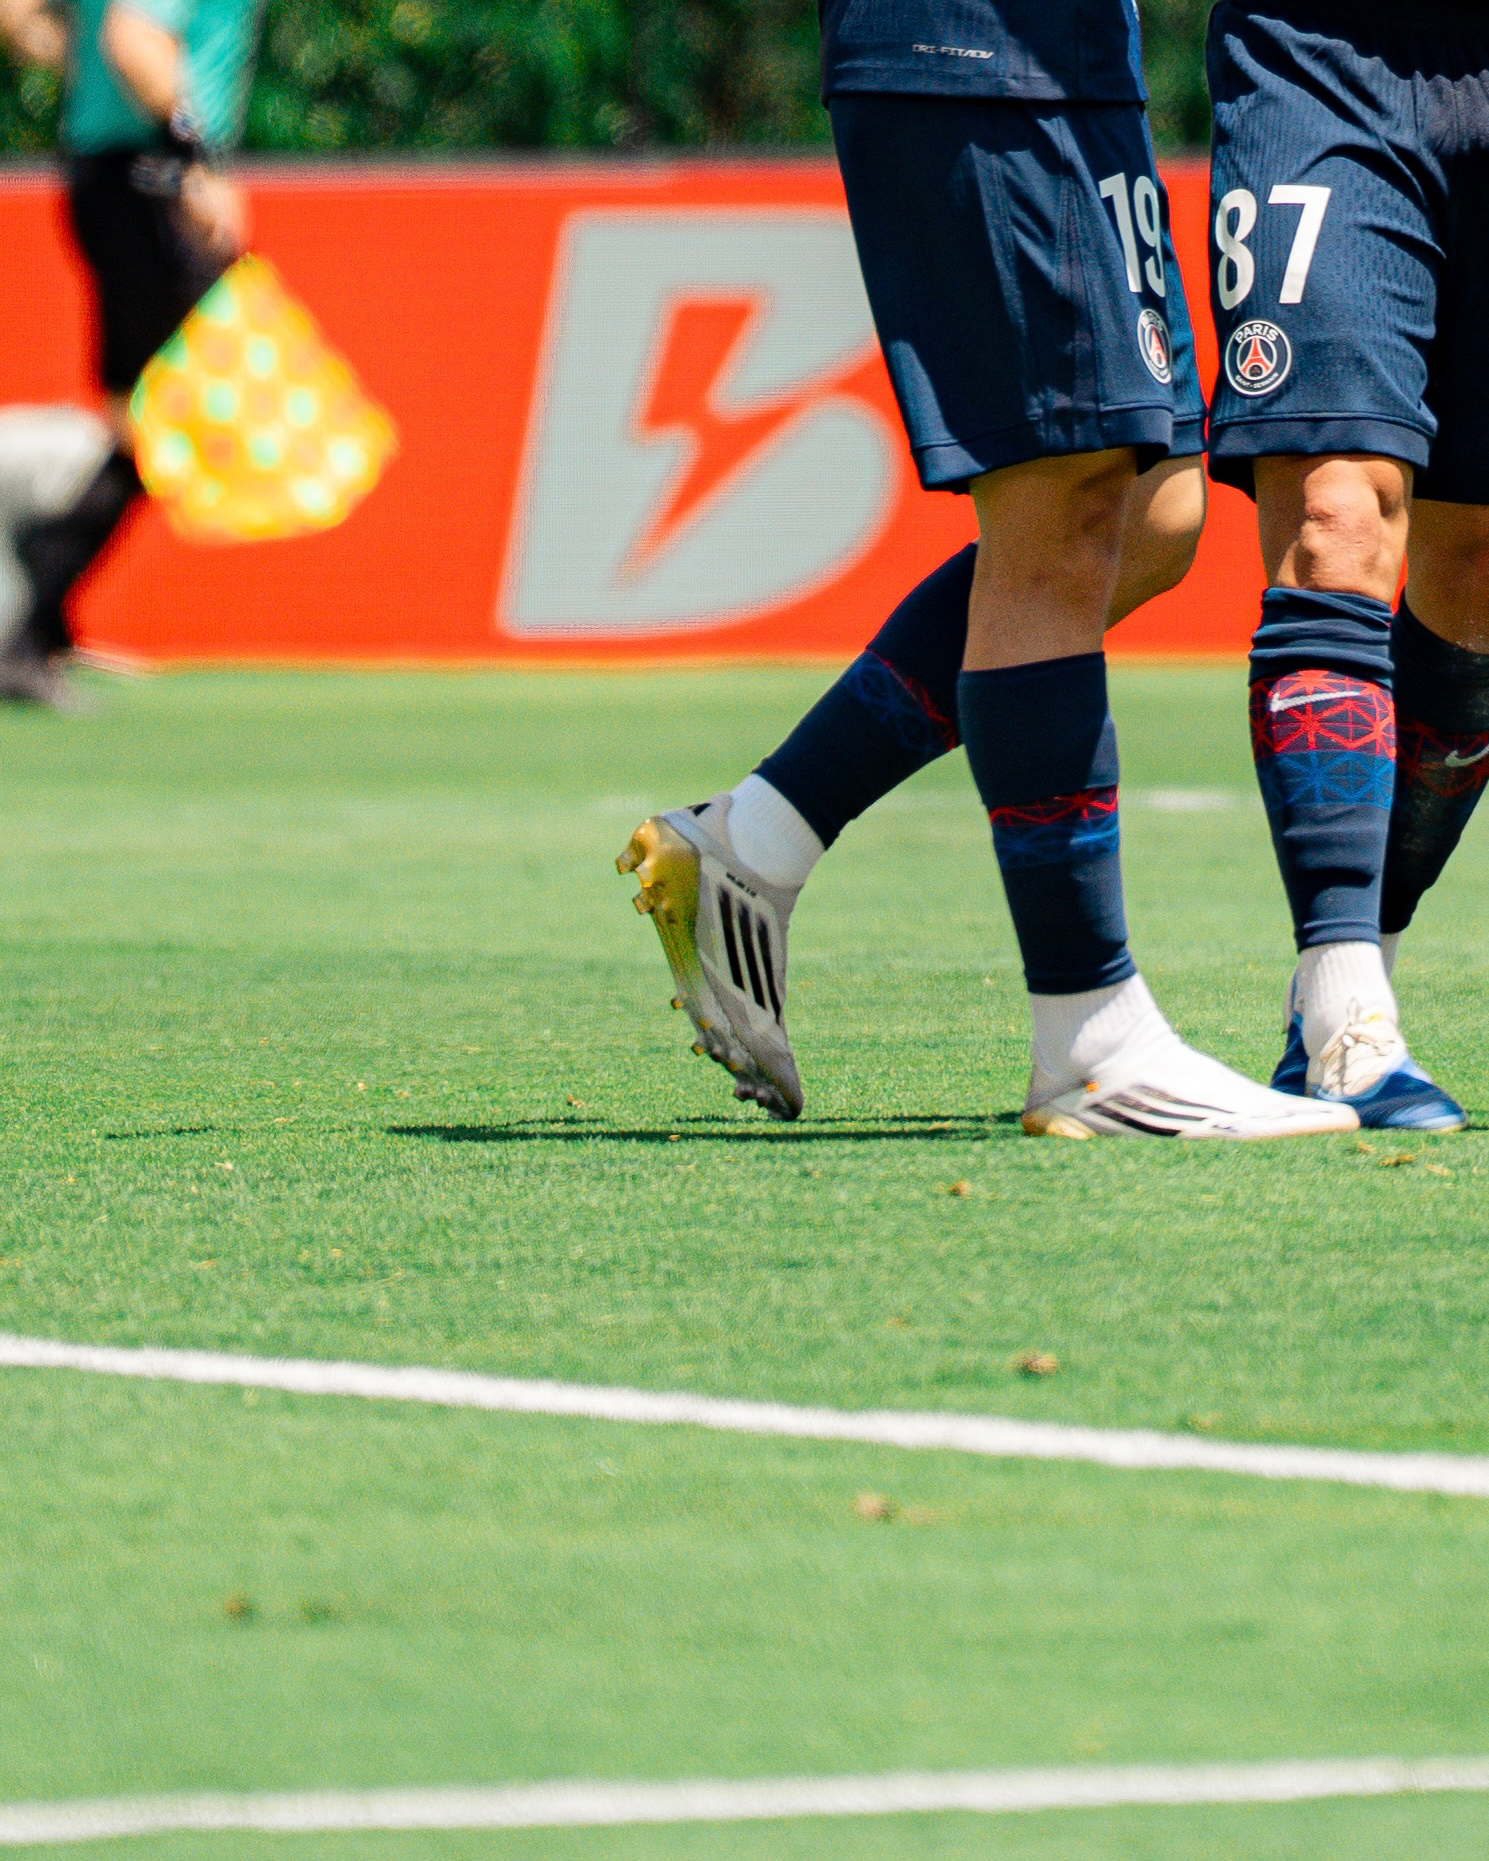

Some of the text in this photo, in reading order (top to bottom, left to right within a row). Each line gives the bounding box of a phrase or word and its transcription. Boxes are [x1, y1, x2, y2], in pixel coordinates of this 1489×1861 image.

[1098, 172, 1166, 298] 19
[1215, 184, 1332, 311] 87
[1234, 323, 1279, 344] PARIS
